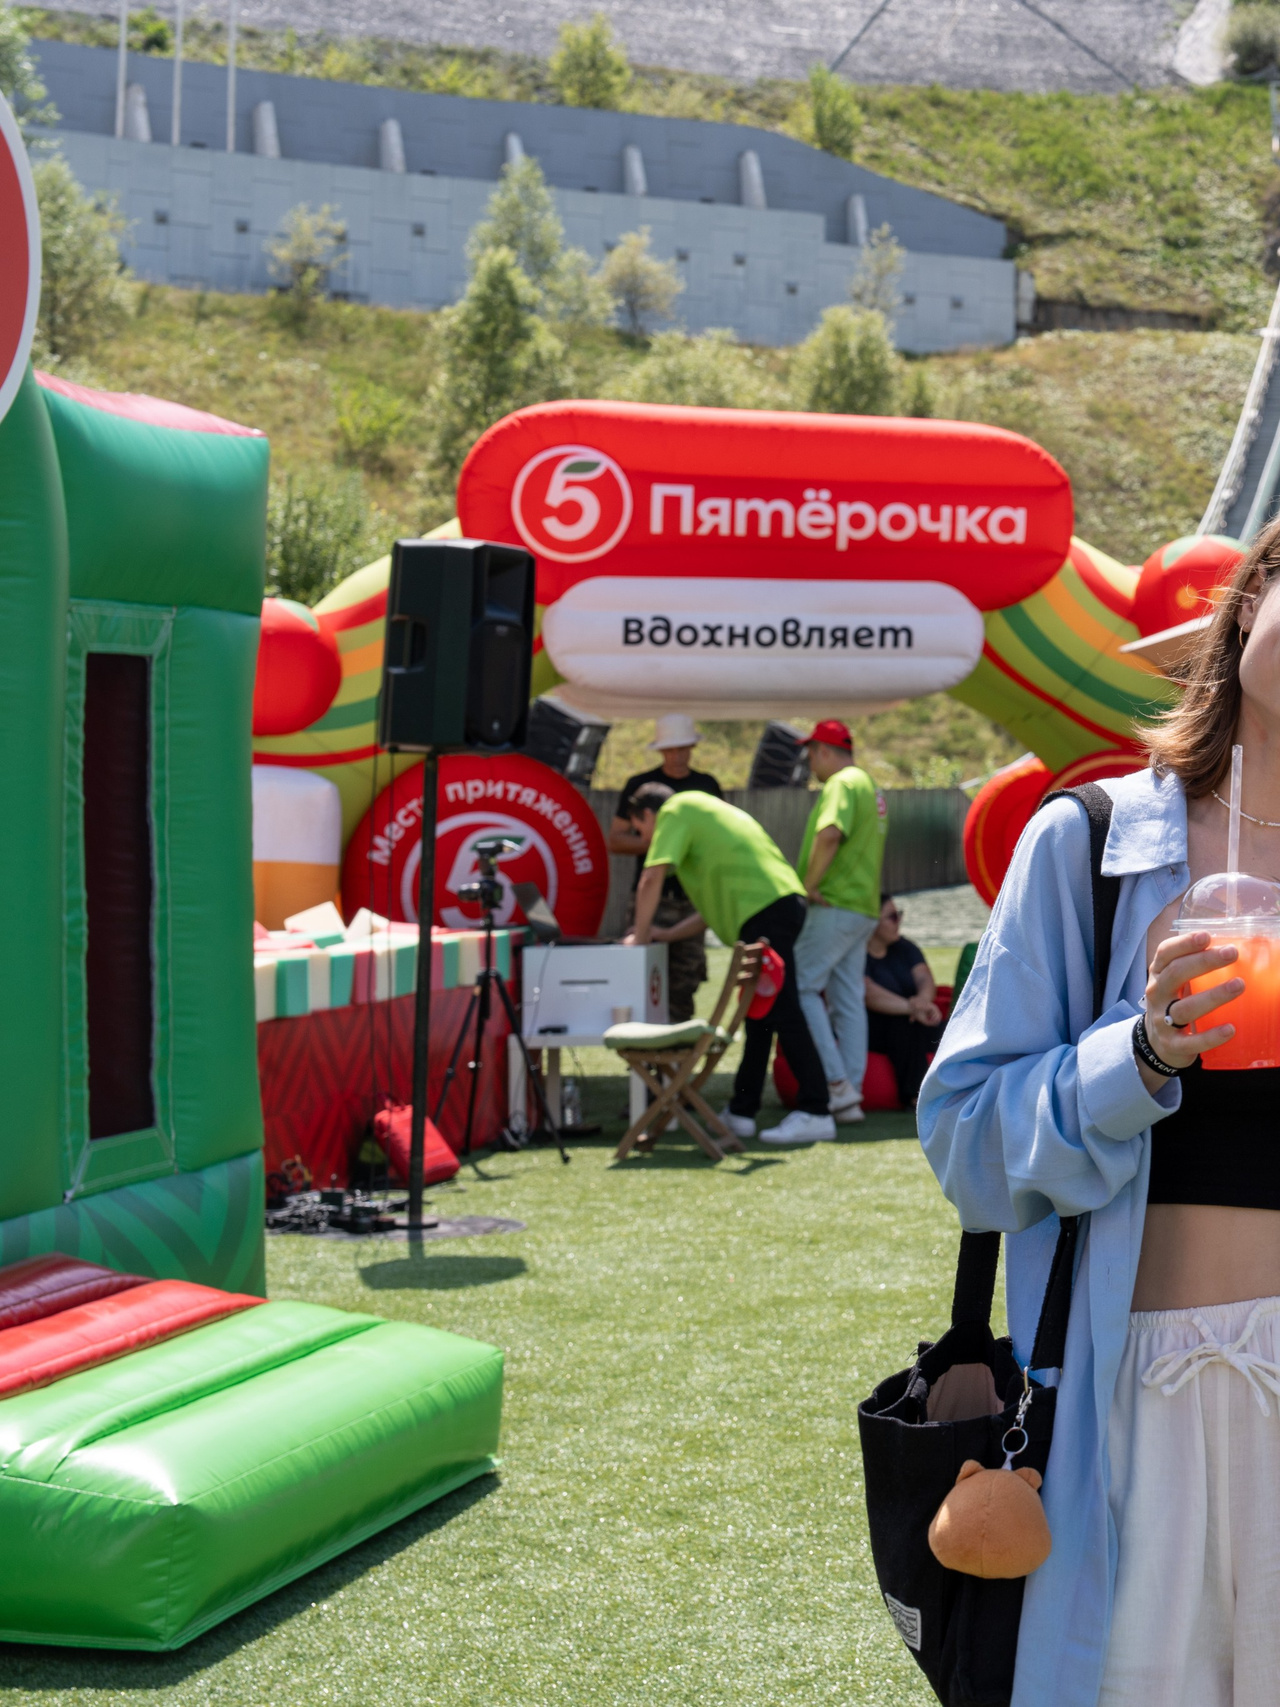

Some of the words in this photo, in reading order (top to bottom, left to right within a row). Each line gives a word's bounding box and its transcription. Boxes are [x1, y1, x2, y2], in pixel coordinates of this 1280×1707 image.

[650, 483, 1027, 552] Пятёрочка
[622, 615, 914, 649] Вдохновляет
[366, 796, 424, 866] Мест
[445, 779, 594, 876] притяжения
